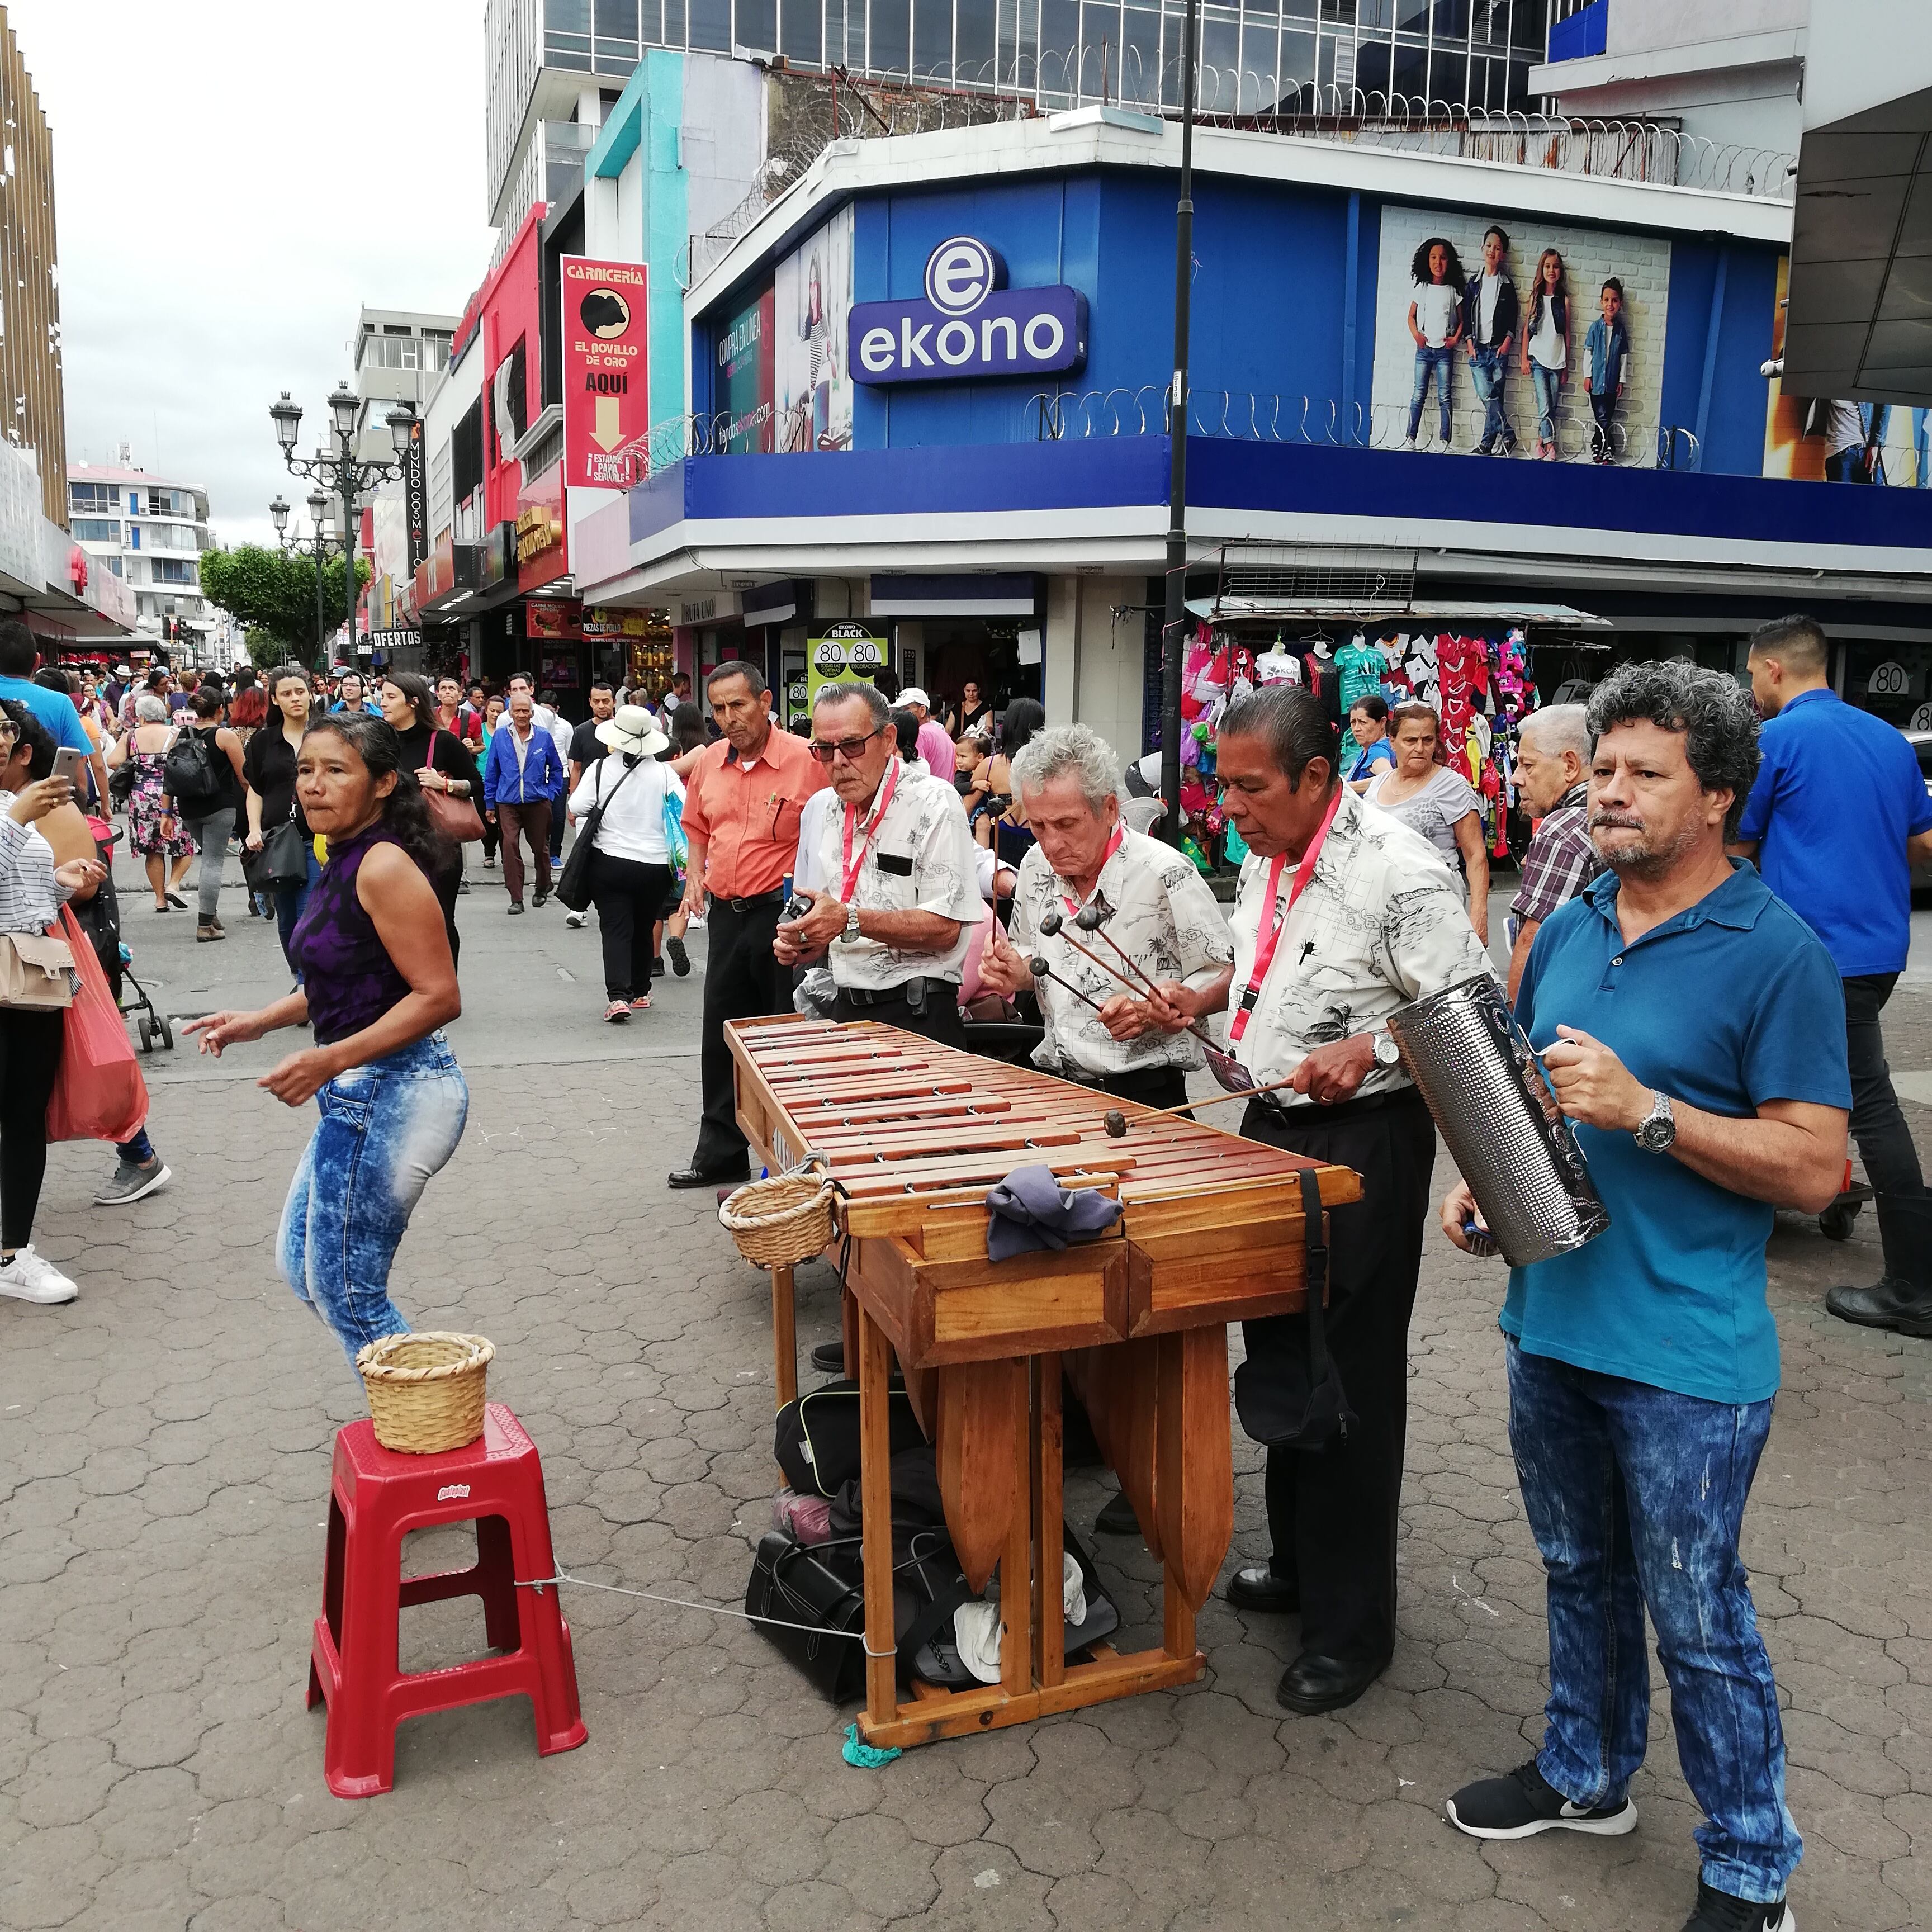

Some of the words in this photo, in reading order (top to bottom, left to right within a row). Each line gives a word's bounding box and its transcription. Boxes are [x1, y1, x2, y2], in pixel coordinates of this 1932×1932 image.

[566, 266, 645, 285] CARNICERÍA
[575, 341, 589, 352] EL
[860, 313, 1064, 372] ekono
[586, 355, 600, 366] DE
[604, 357, 627, 368] ORO
[585, 371, 629, 395] AQUÍ
[410, 442, 420, 488] MUNDO
[583, 623, 599, 632] PIEZAS
[599, 623, 606, 632] DE
[606, 623, 621, 633] POLLO
[831, 629, 863, 638] BLACK
[373, 631, 421, 647] OFERTAS
[820, 644, 841, 662] 80
[854, 644, 875, 662] 80
[1876, 667, 1902, 693] 80
[793, 686, 807, 698] 80
